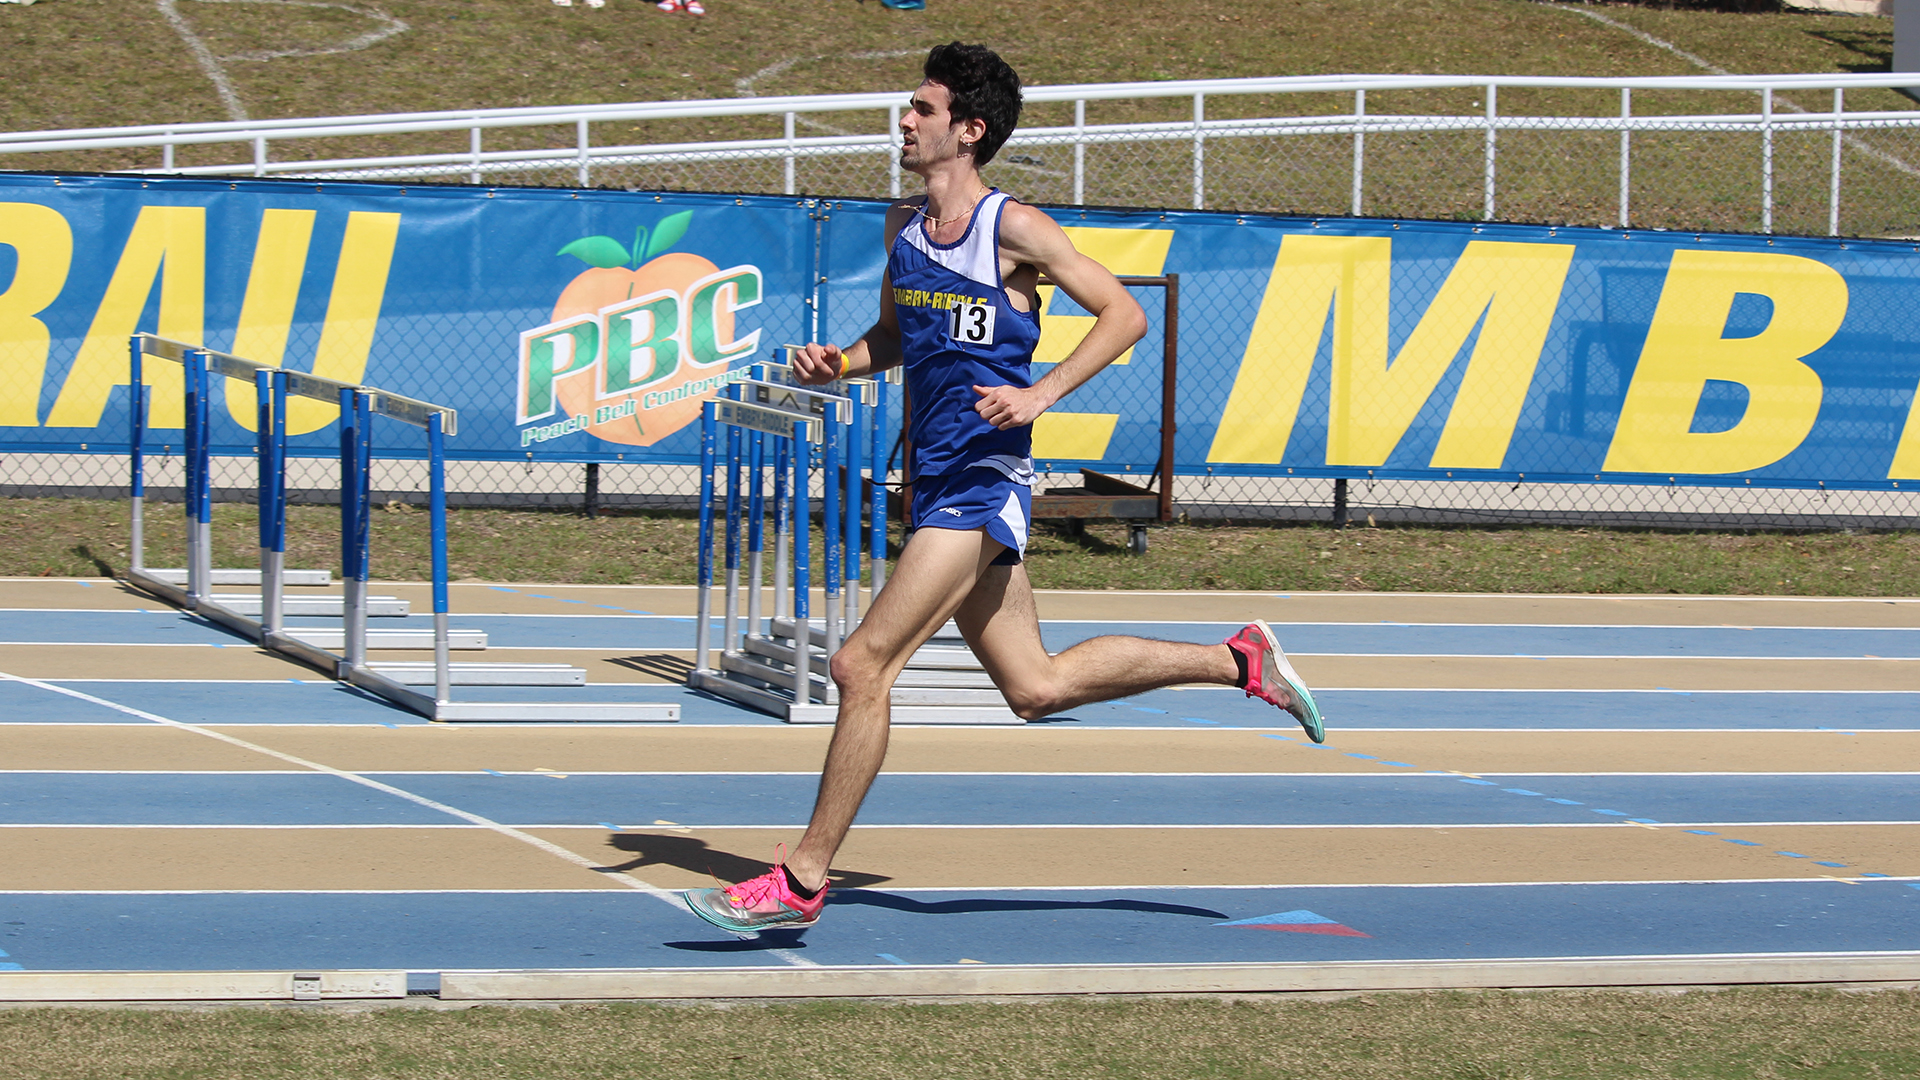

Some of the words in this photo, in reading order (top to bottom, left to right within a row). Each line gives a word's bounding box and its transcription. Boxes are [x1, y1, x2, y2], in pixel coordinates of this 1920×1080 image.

[516, 265, 763, 426] PBC
[951, 303, 987, 341] 13
[1030, 226, 1920, 480] EMB
[520, 414, 589, 448] Peach
[595, 399, 639, 425] Belt
[643, 365, 752, 411] Conferenc
